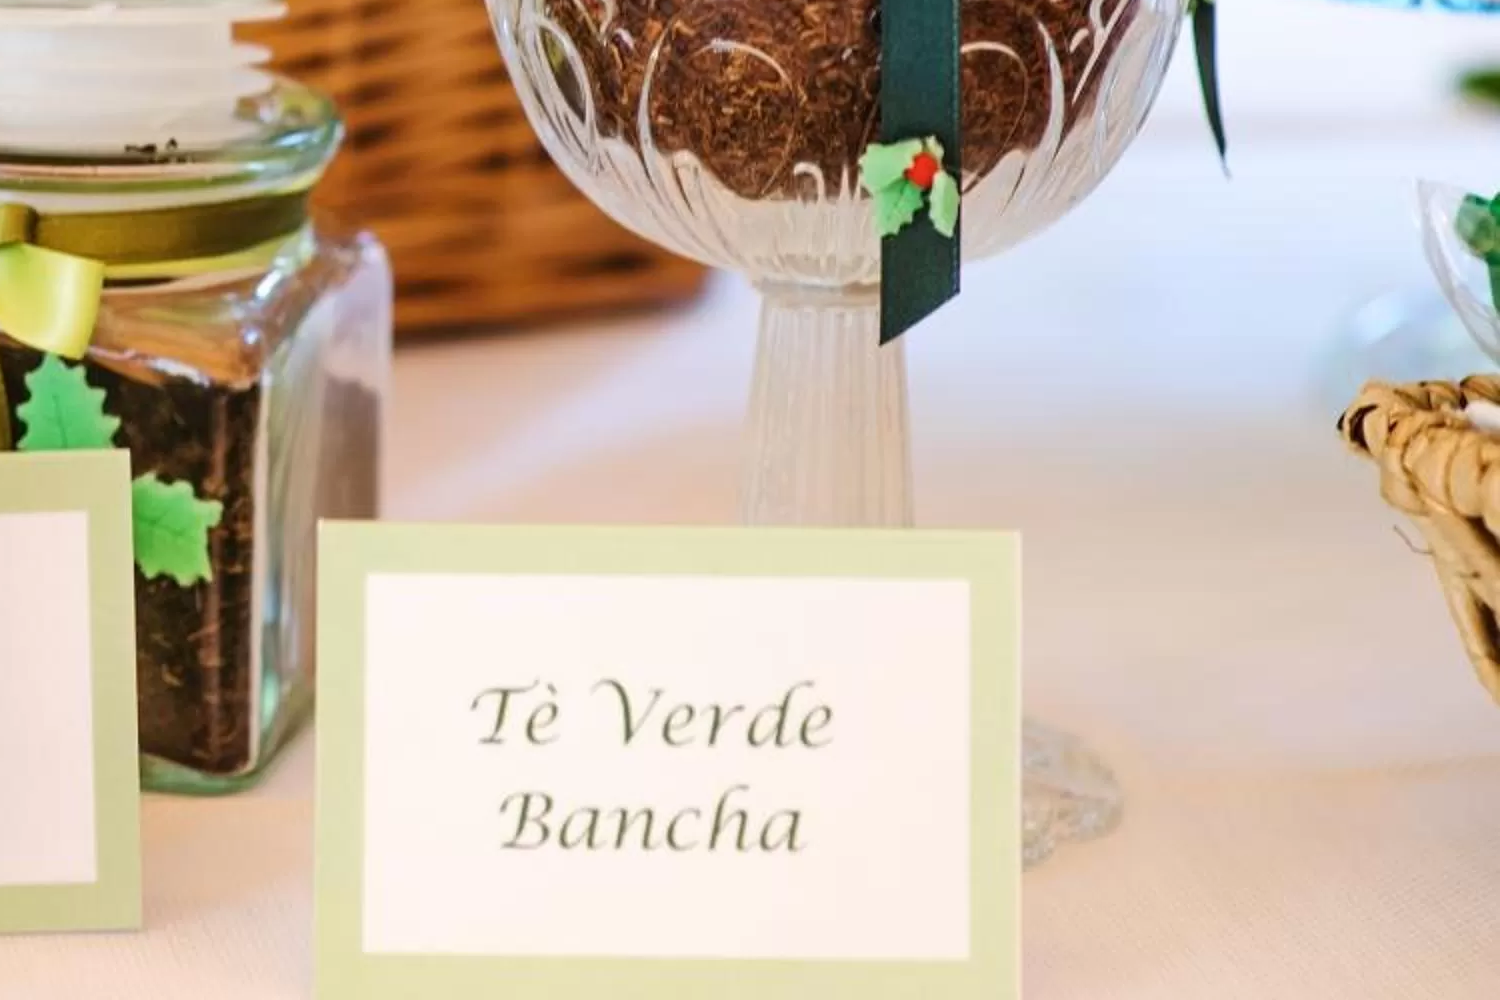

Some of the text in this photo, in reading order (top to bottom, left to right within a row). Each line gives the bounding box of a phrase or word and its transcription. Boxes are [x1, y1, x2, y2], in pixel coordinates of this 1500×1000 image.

[471, 679, 835, 749] Tè Verde
[498, 785, 807, 853] Bancha
